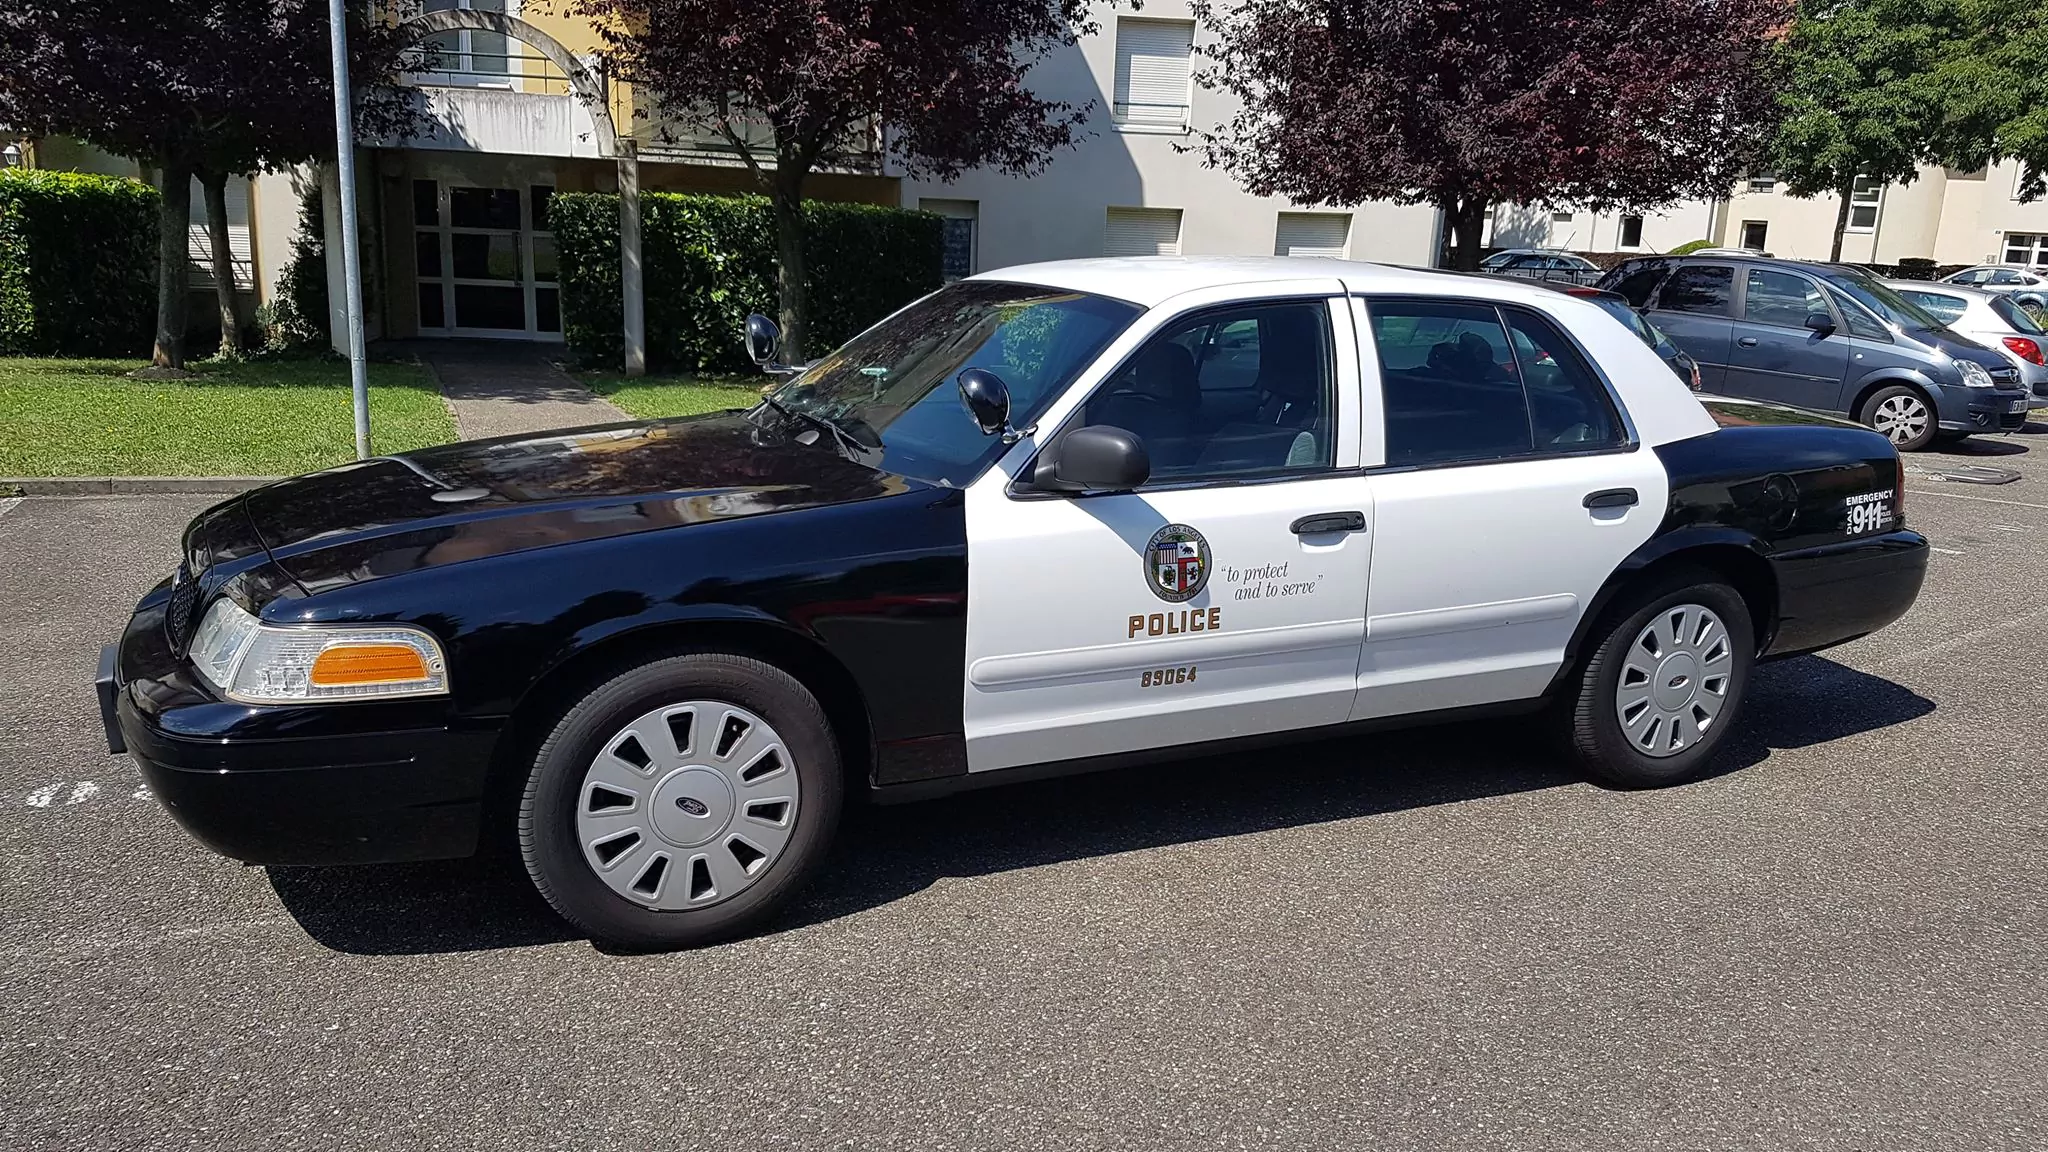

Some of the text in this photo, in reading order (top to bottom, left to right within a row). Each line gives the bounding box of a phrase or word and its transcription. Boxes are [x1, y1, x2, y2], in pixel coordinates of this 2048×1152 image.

[1846, 489, 1893, 506] EMERGENCY
[1149, 537, 1160, 552] CITY
[1159, 529, 1167, 538] OF
[1182, 527, 1206, 549] ANGELES
[1243, 561, 1289, 584] protect
[1158, 590, 1185, 600] FOUNDED
[1234, 582, 1262, 601] and
[1265, 582, 1278, 598] to
[1128, 606, 1221, 639] POLICE
[1140, 666, 1197, 688] 89064
